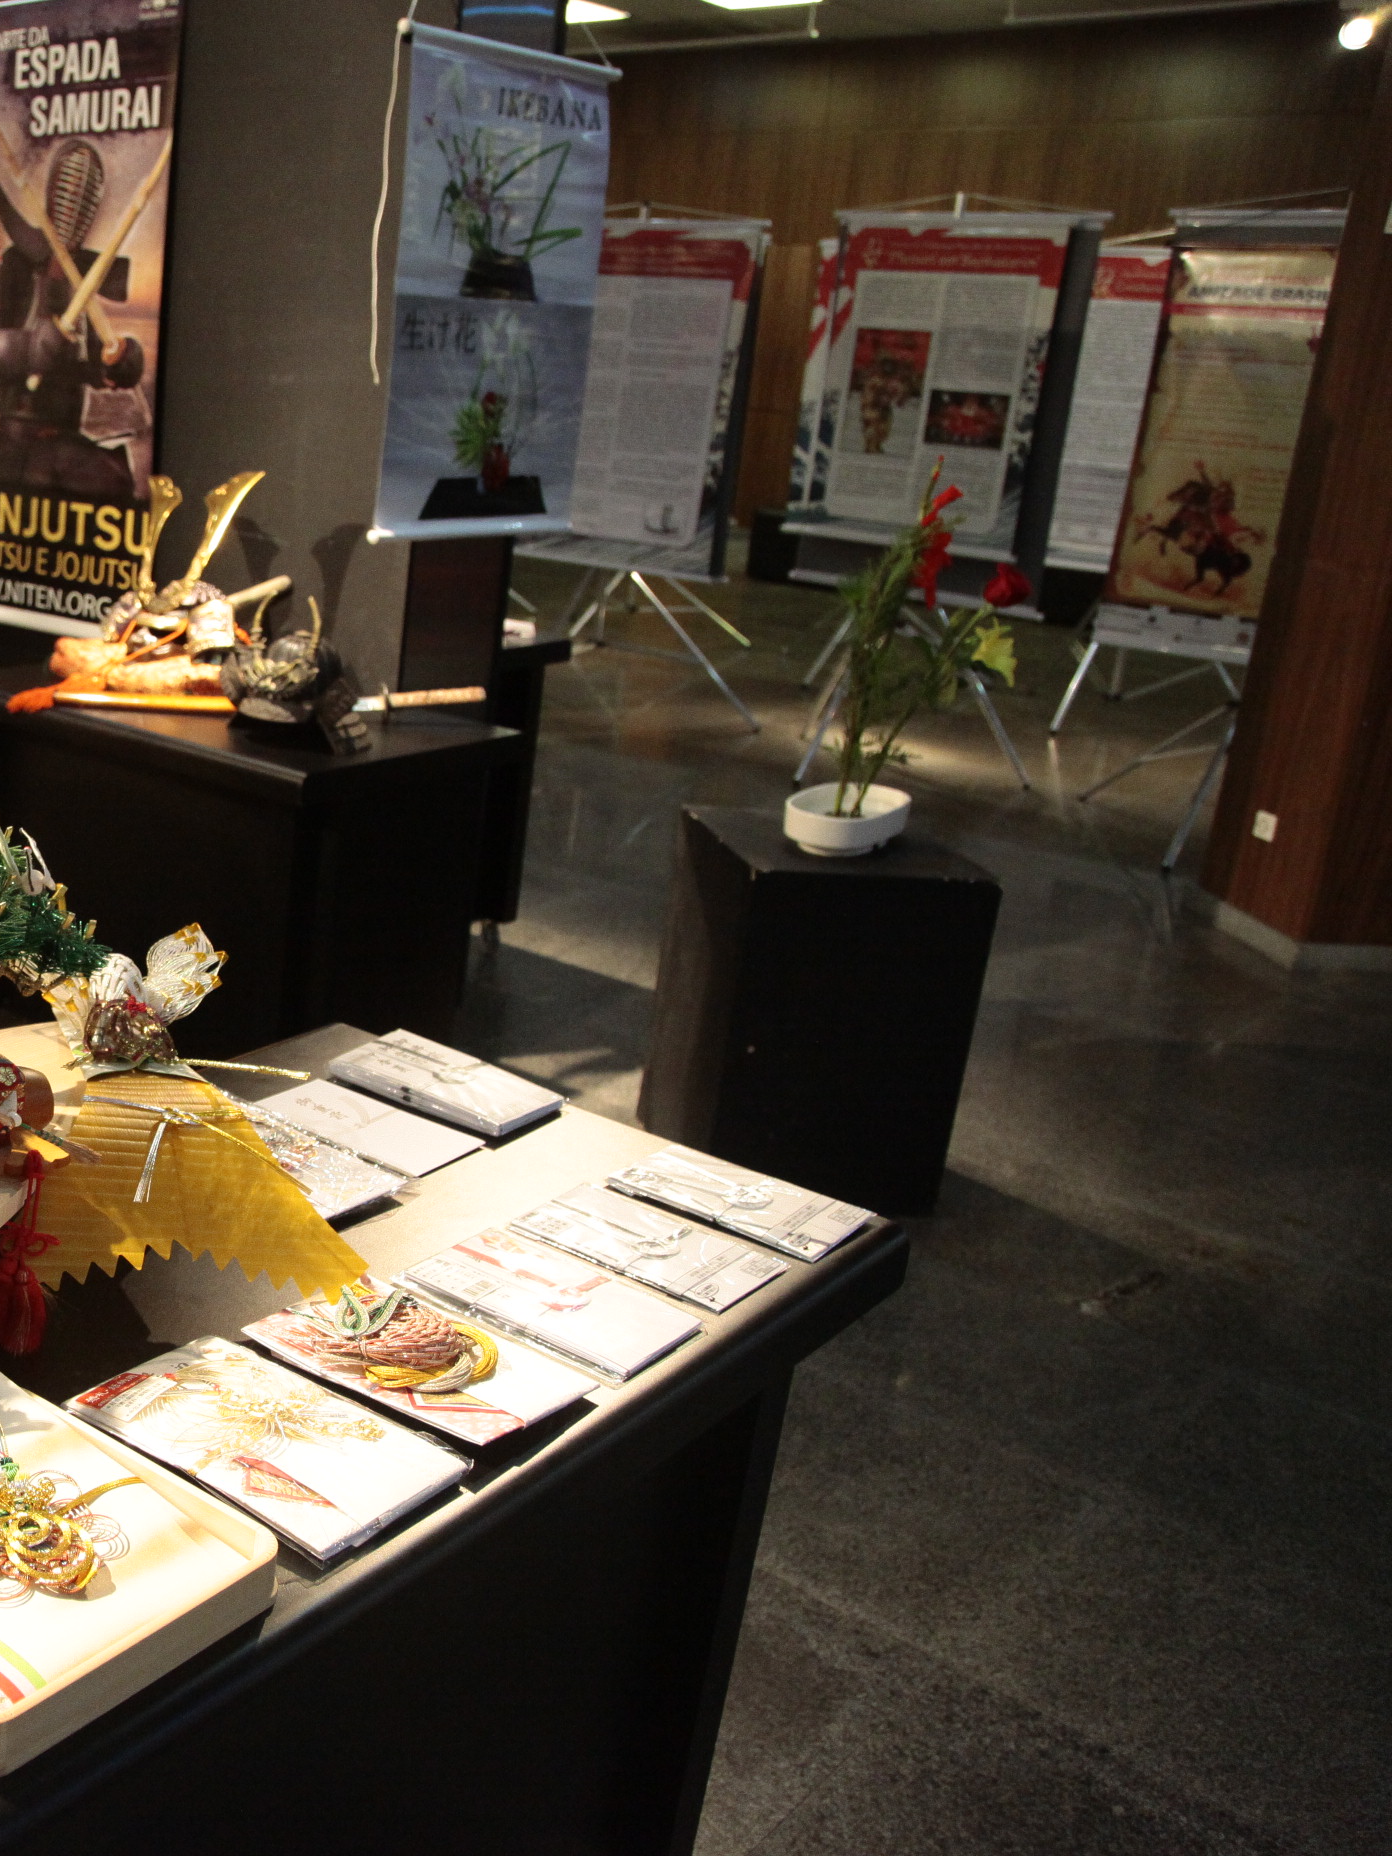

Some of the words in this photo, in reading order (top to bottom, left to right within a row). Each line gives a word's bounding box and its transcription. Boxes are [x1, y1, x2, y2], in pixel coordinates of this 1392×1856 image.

[28, 26, 50, 46] DA
[14, 37, 121, 89] ESPADA
[29, 85, 161, 138] SAMURAI
[497, 86, 602, 131] IKEBANA
[36, 547, 49, 576] E
